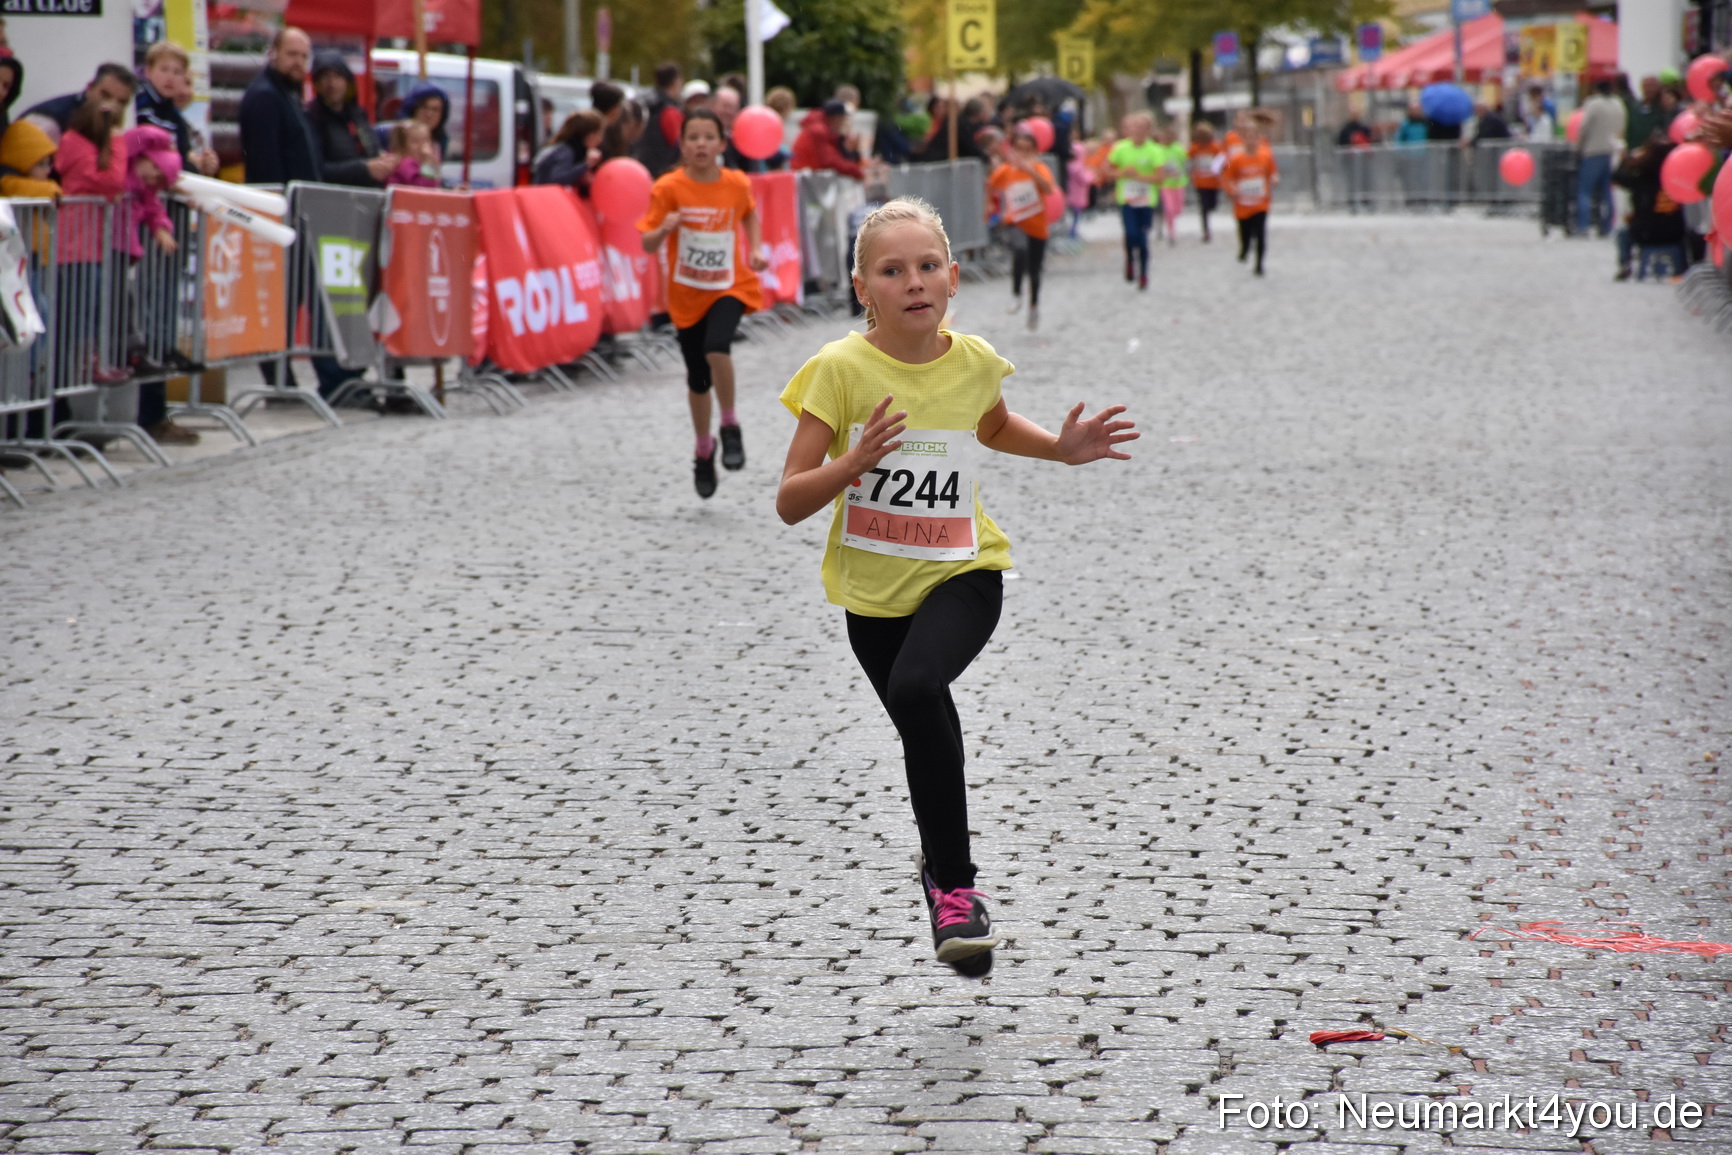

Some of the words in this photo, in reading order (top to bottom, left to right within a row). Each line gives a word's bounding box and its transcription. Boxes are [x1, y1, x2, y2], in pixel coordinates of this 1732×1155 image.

[959, 18, 984, 53] C
[686, 245, 727, 267] 7282
[868, 467, 960, 510] 7244
[866, 517, 950, 545] ALINA
